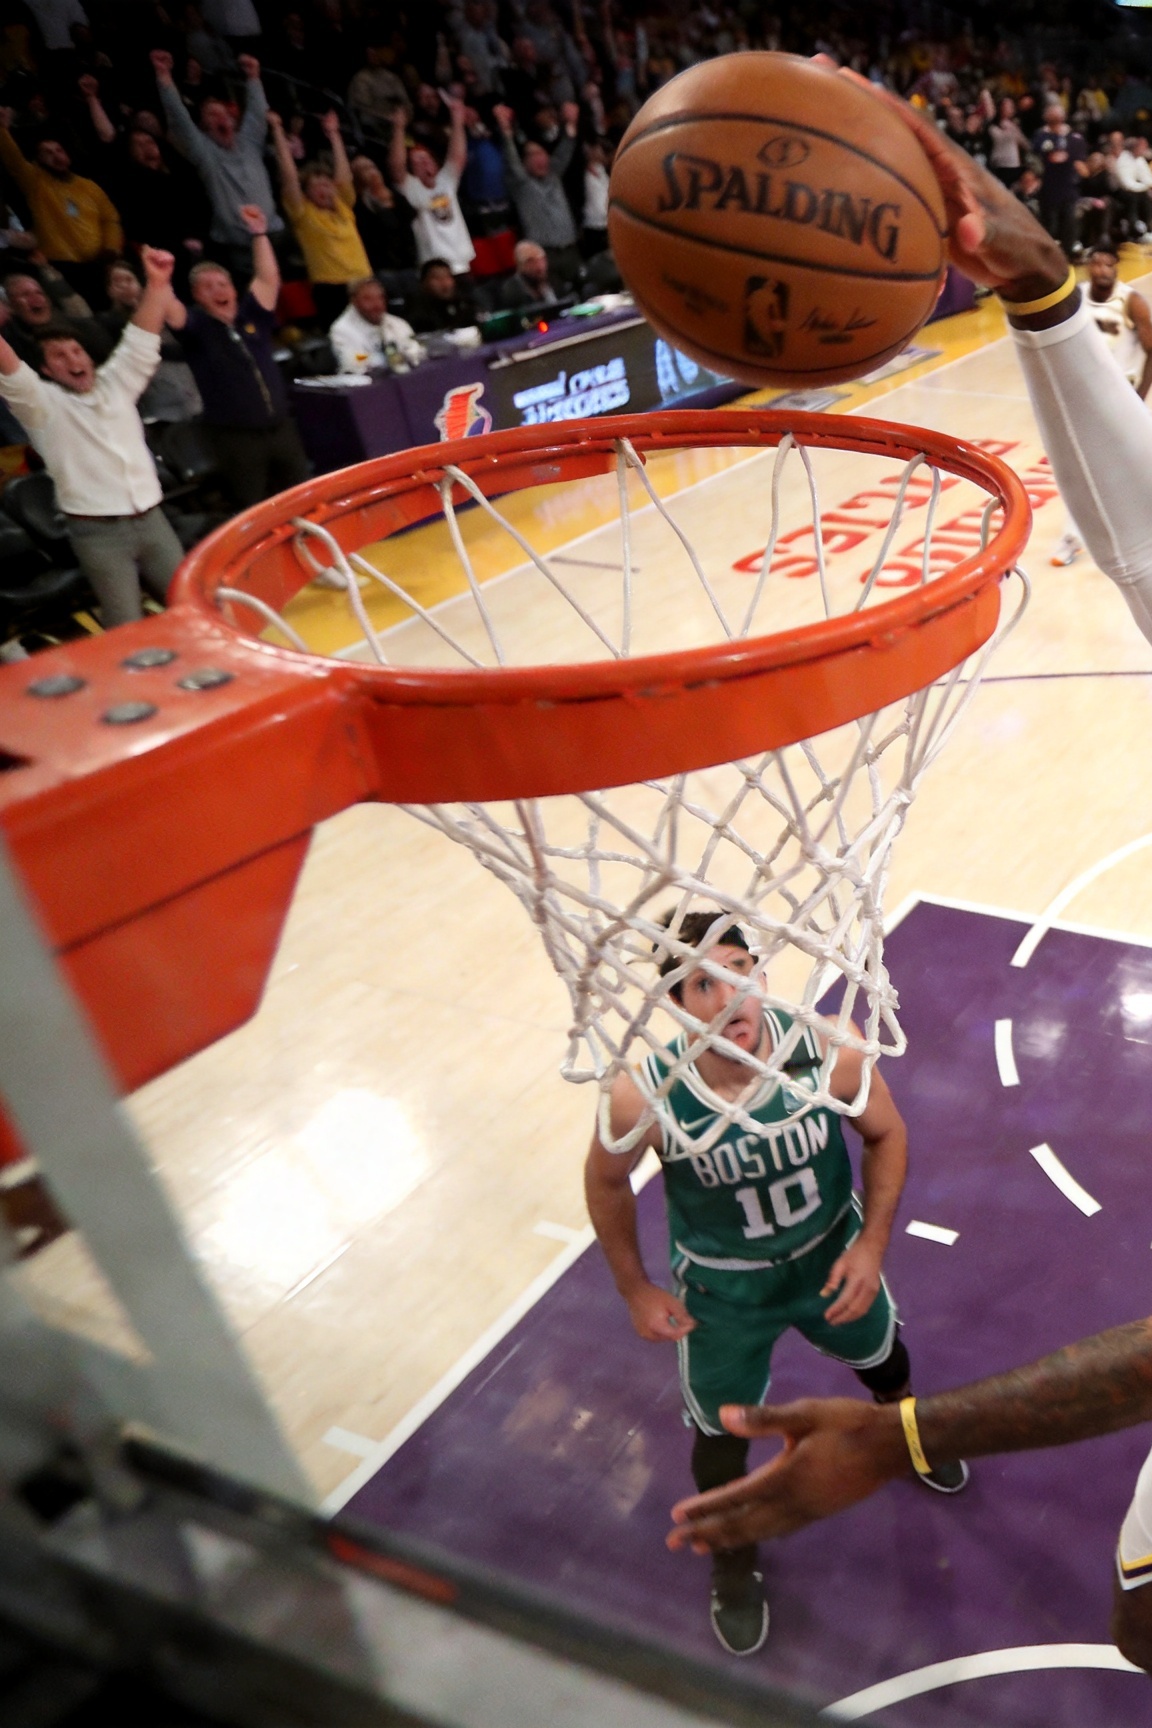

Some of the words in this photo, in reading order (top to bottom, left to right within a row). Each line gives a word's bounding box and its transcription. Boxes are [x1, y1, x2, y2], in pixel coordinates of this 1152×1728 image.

[659, 151, 901, 264] SPALDING
[690, 1112, 829, 1189] BOSTON
[734, 1166, 823, 1240] 10
